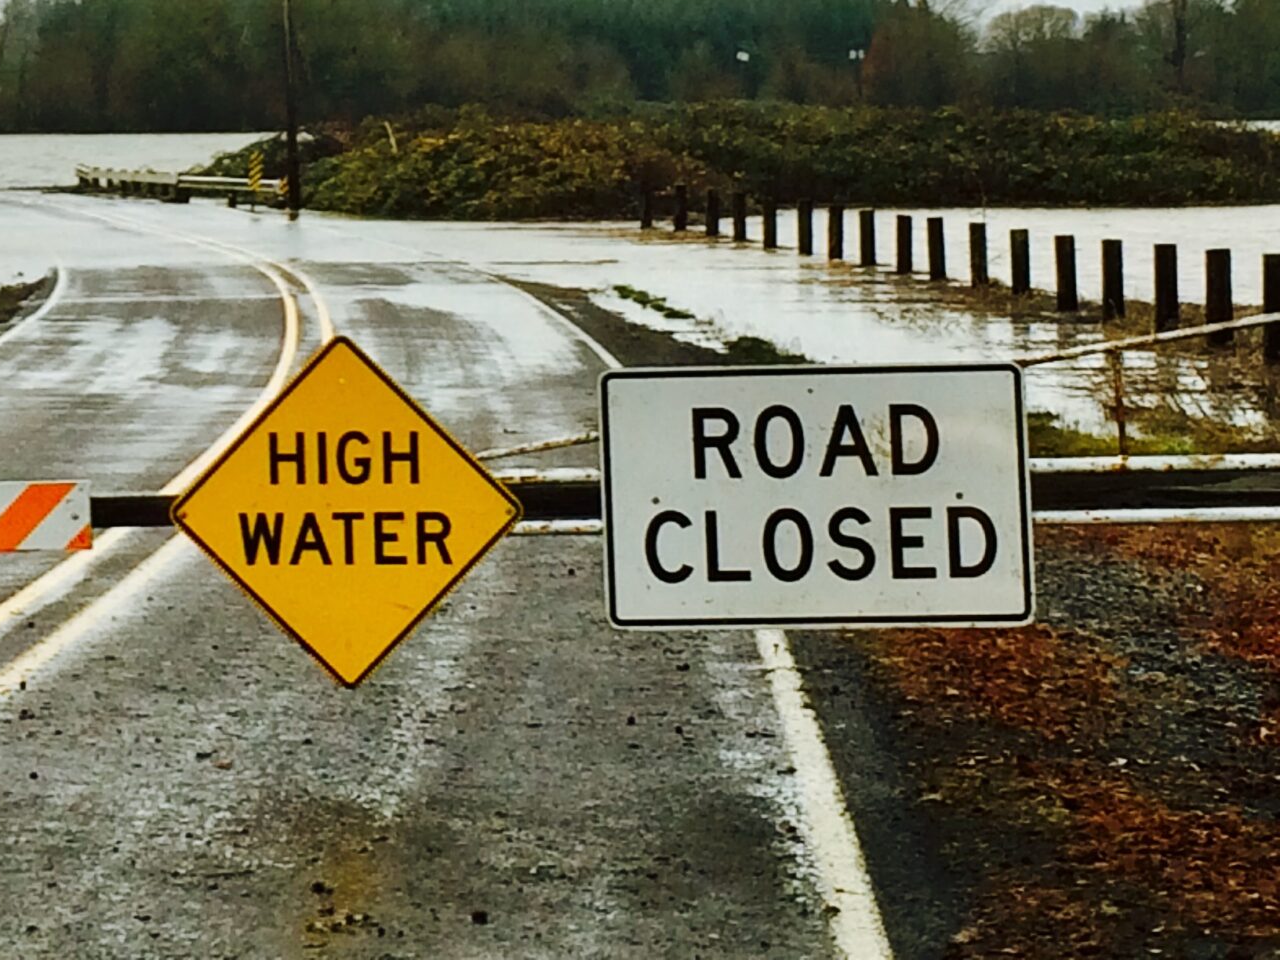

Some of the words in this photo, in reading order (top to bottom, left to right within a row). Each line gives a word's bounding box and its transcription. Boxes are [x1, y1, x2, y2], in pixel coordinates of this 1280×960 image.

[269, 430, 421, 486] HIGH
[691, 403, 940, 480] ROAD
[238, 511, 454, 567] WATER
[644, 505, 998, 584] CLOSED
